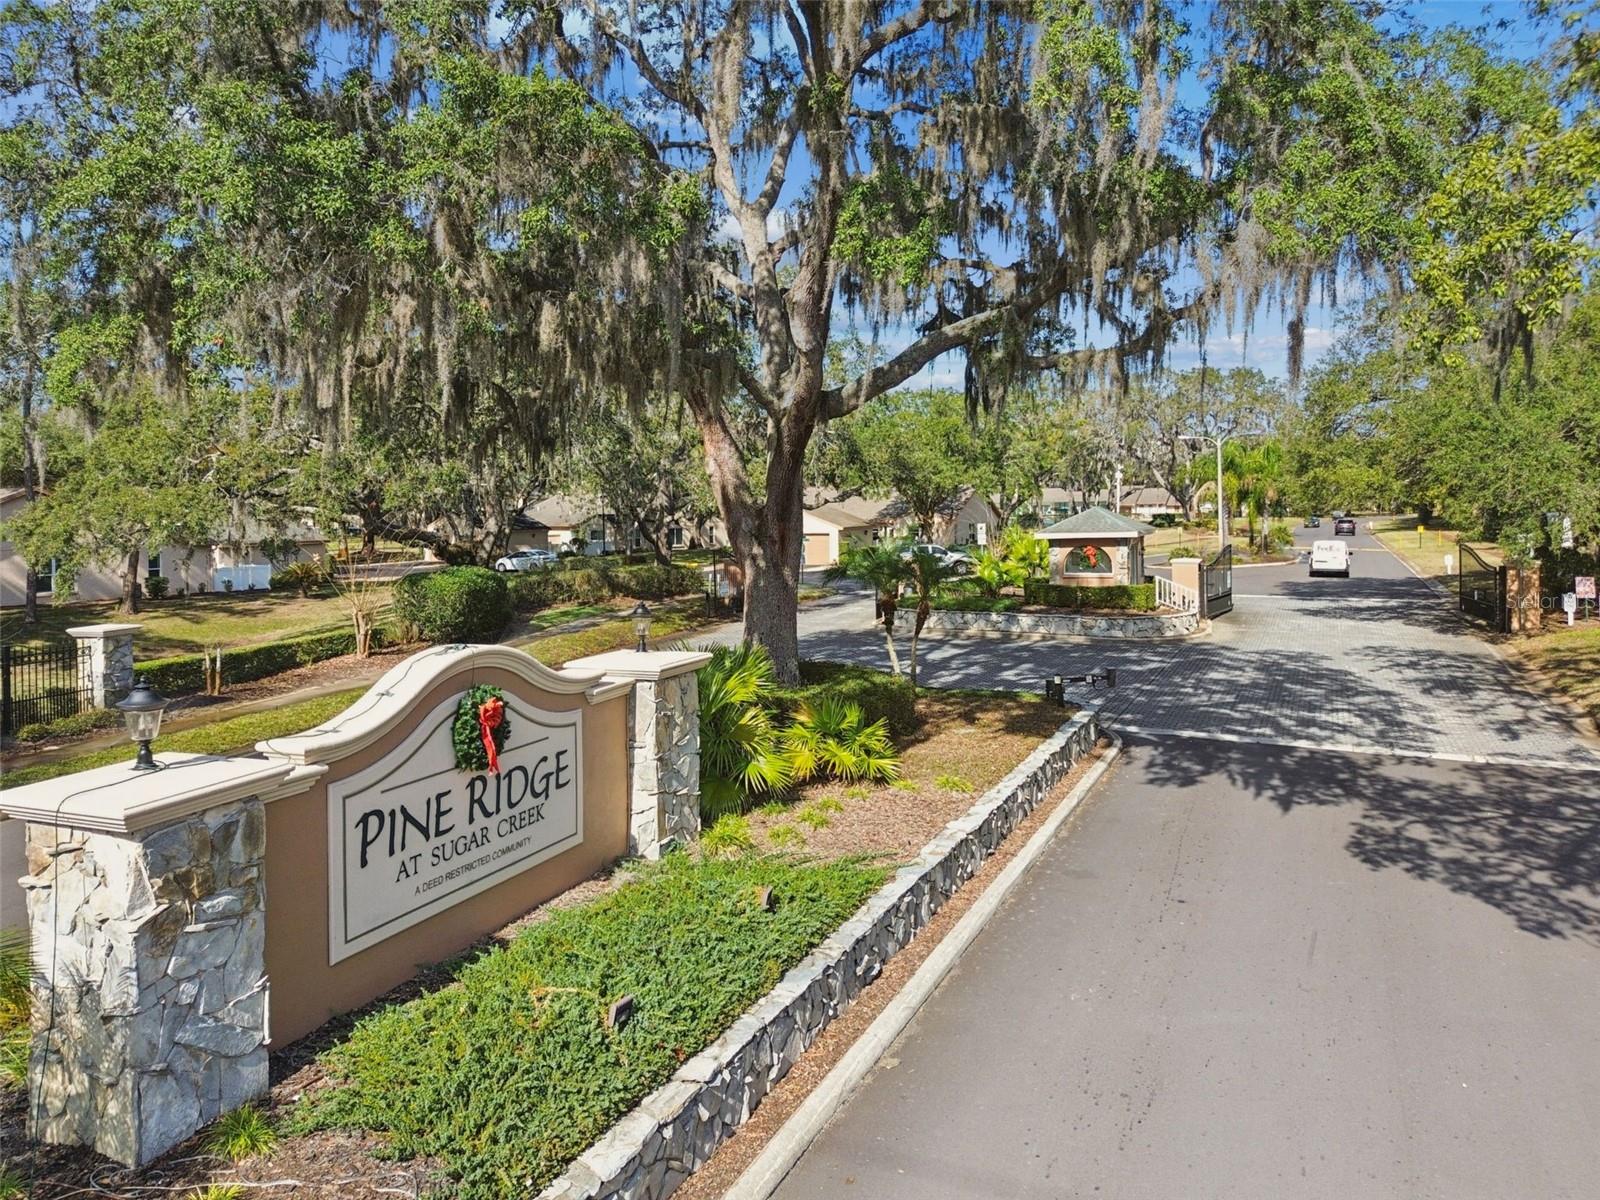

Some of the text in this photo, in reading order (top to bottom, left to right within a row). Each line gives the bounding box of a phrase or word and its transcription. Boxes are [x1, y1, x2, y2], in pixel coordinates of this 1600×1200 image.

[355, 749, 571, 868] PINE RIDGE
[396, 802, 545, 882] AT SUGAR CREEK
[414, 836, 532, 896] A DEED RESTRICTED COMMUNITY
